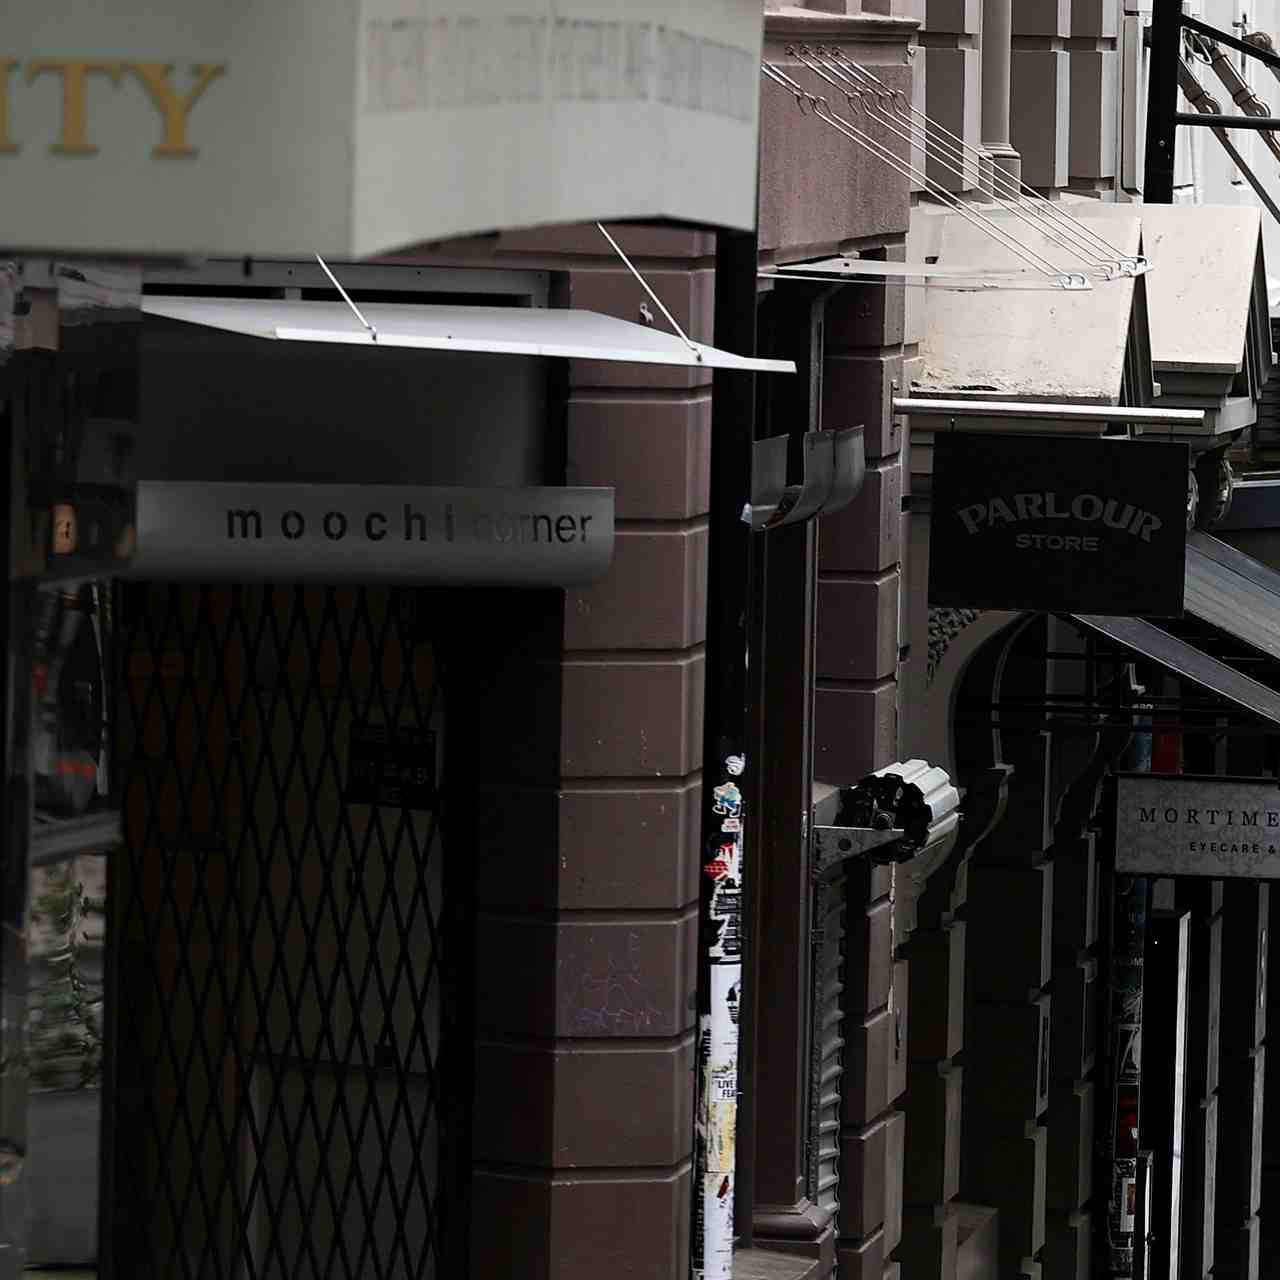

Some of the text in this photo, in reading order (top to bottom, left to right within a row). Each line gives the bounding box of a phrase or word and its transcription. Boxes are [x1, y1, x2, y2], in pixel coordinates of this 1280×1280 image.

[227, 504, 455, 541] moochi
[958, 492, 1162, 543] PARLOUR
[1016, 533, 1099, 551] STORE
[1189, 841, 1260, 855] EYECARE
[1268, 845, 1275, 855] &
